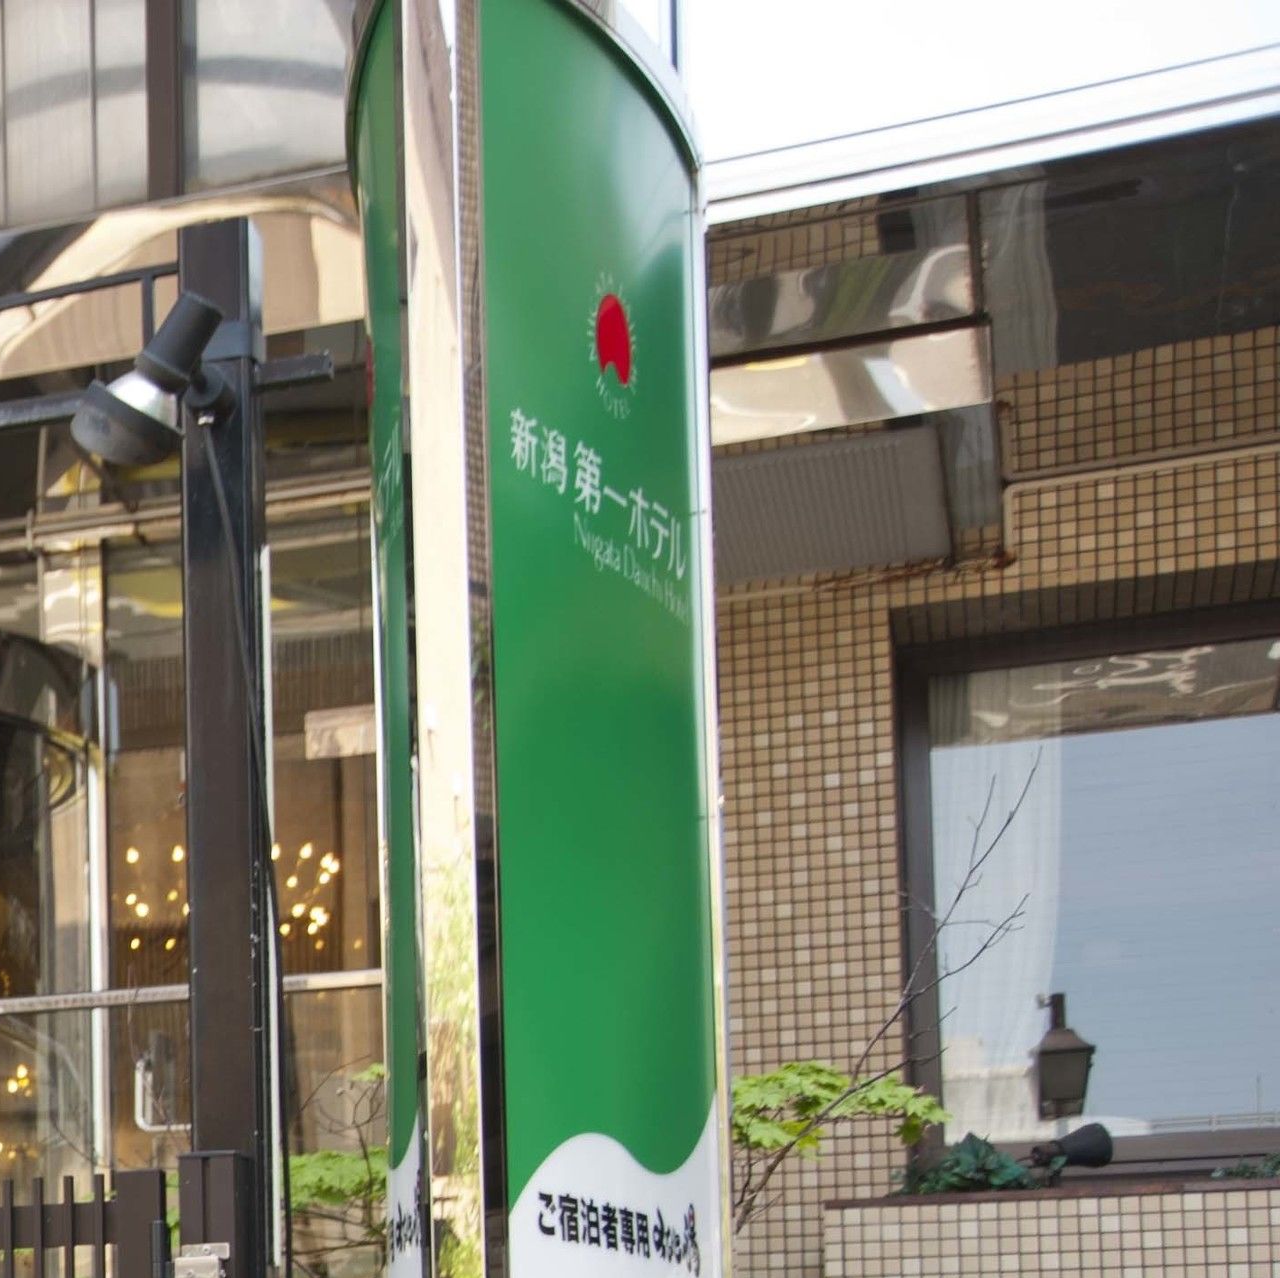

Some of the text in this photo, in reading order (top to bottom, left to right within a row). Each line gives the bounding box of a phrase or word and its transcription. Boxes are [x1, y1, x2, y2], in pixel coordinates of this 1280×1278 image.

[509, 407, 687, 581] 新潟第一ホテル
